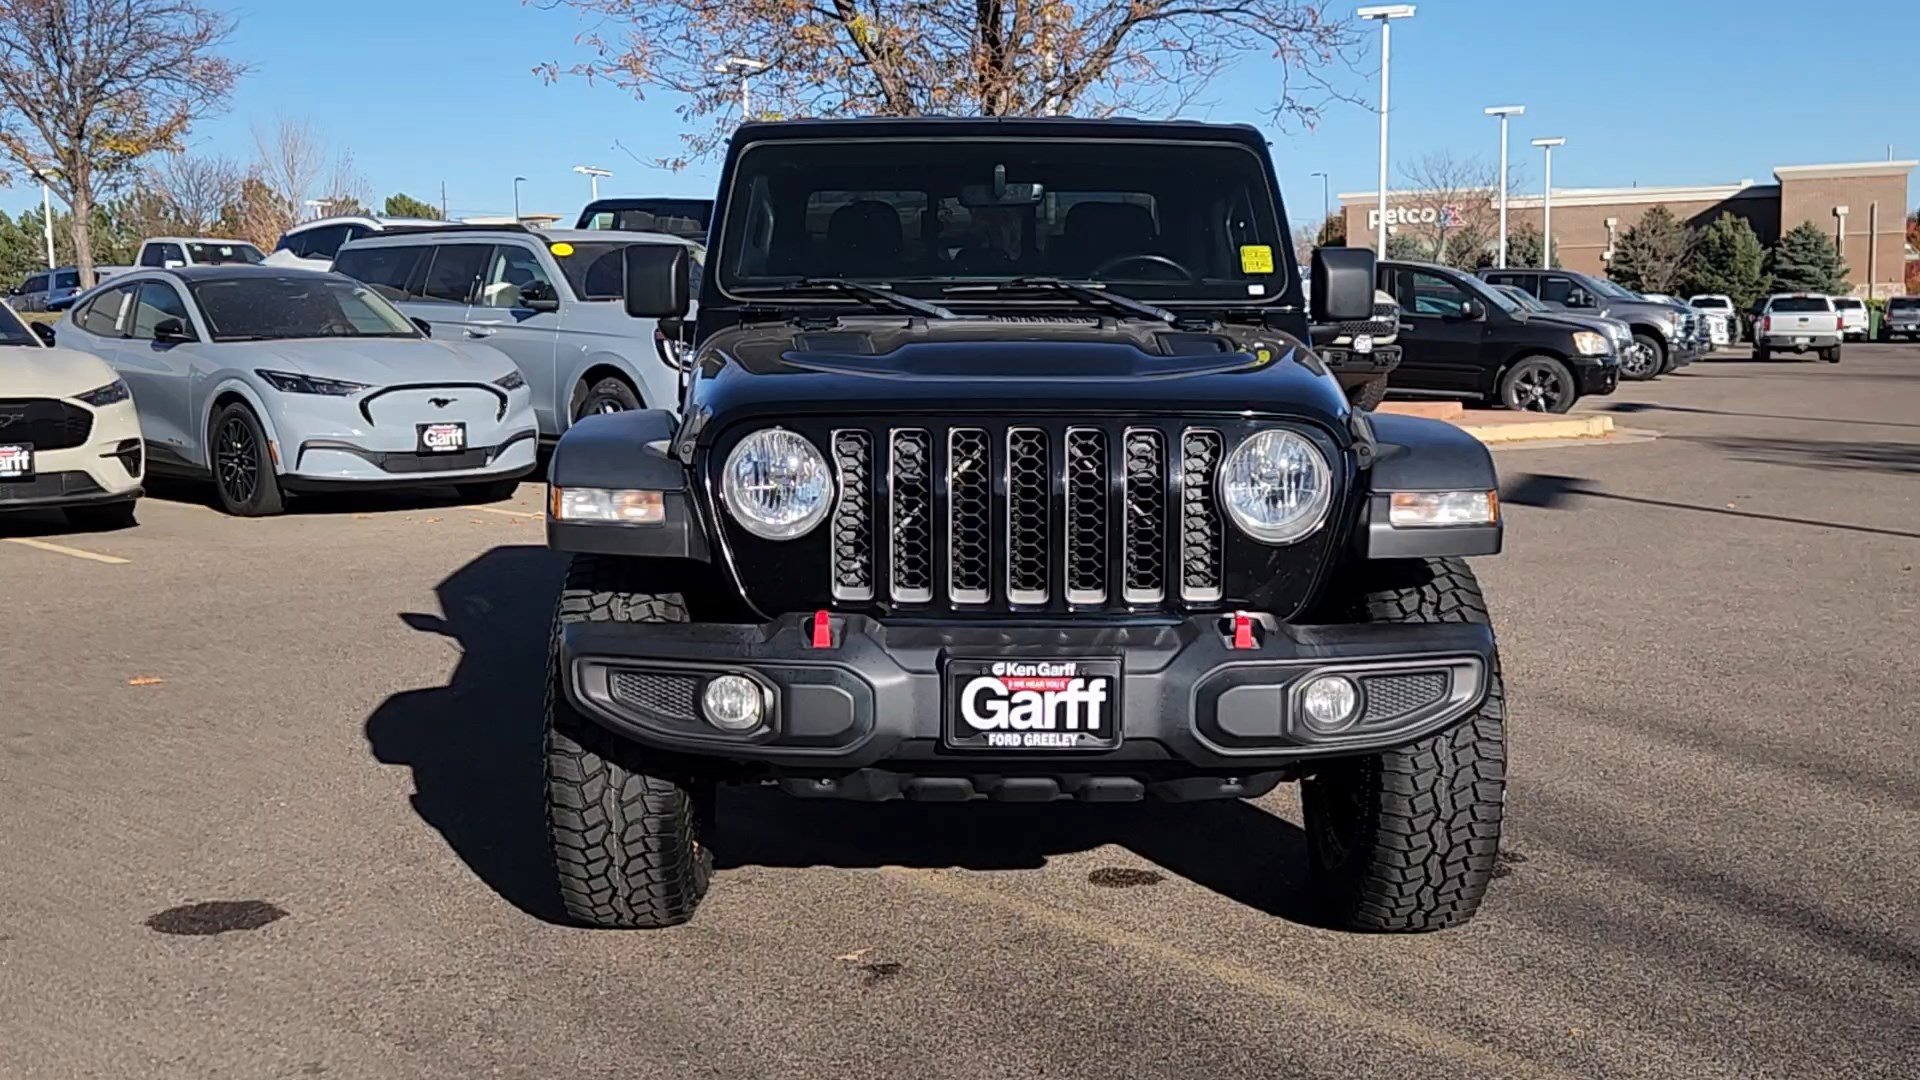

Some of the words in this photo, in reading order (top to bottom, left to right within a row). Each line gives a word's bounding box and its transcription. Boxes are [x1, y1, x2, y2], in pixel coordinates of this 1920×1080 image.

[1368, 206, 1437, 230] petco
[1006, 662, 1036, 676] Ken
[1037, 662, 1077, 676] Garff
[961, 676, 1107, 730] Garff
[988, 733, 1021, 746] FORD
[1023, 733, 1078, 746] GREELEY
